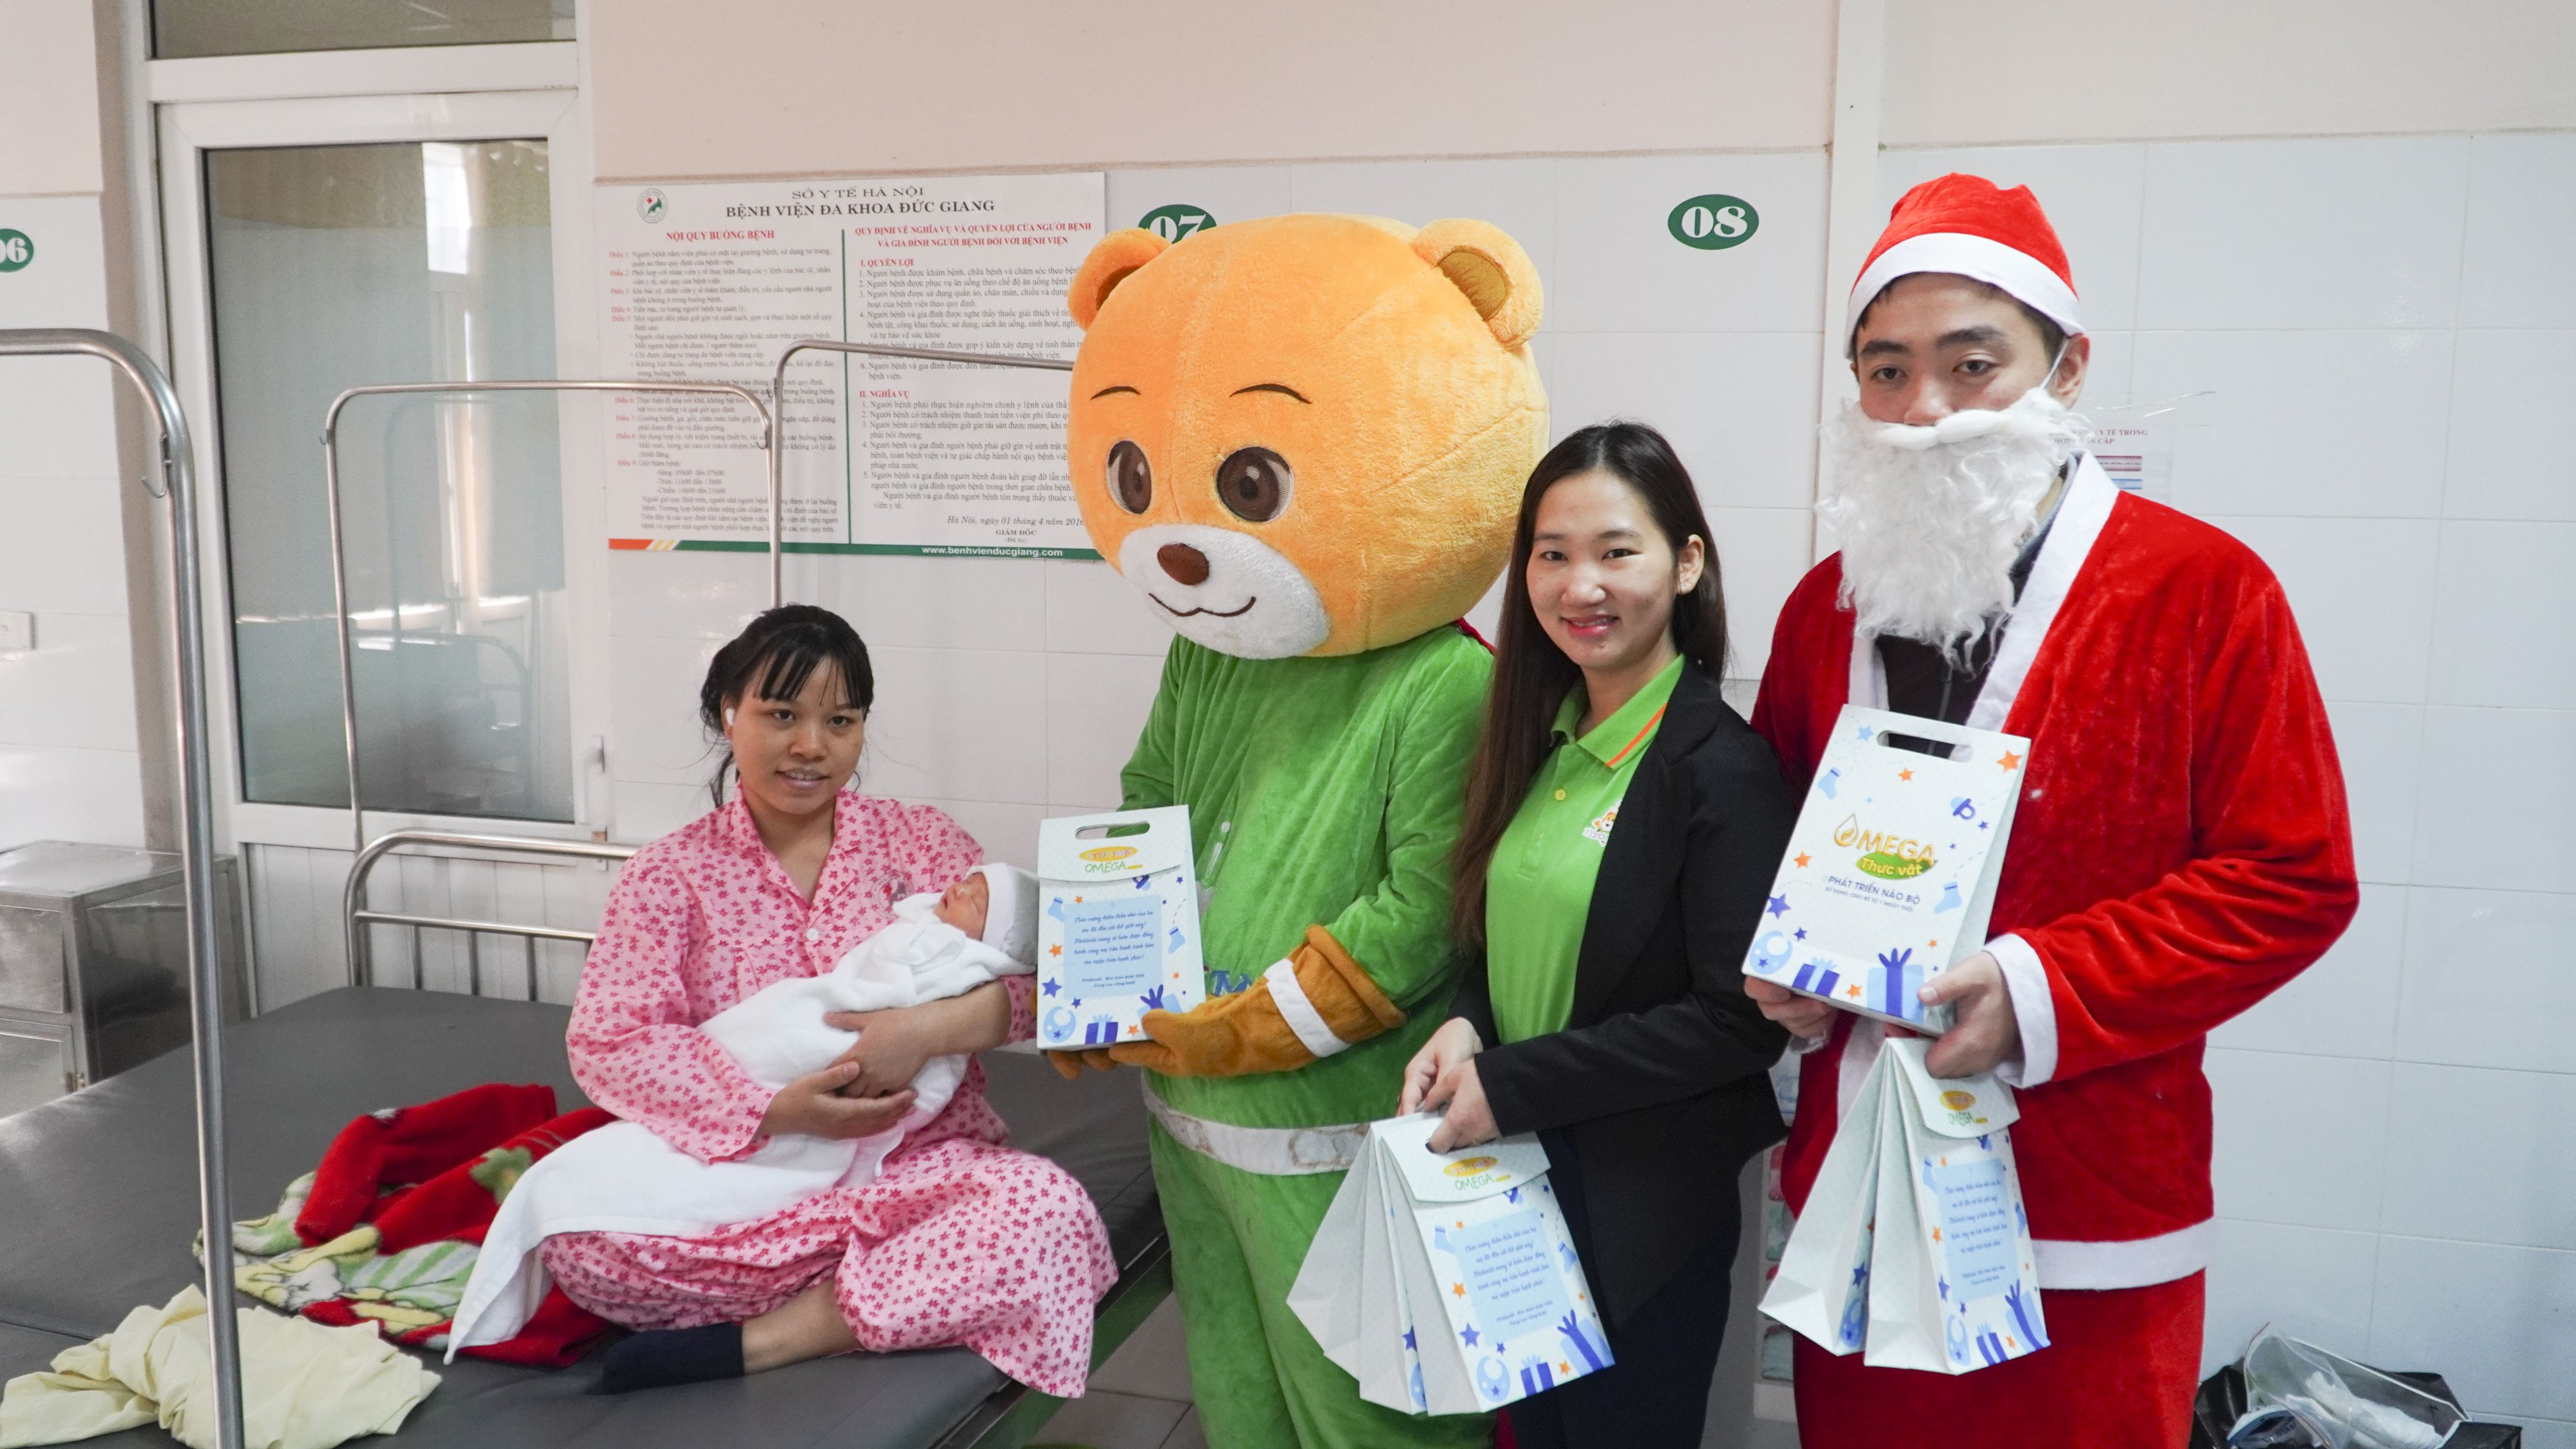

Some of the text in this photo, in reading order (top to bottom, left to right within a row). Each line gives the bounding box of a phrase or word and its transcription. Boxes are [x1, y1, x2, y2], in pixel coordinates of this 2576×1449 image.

[792, 189, 813, 199] SỞ
[835, 187, 856, 197] TẾ
[863, 187, 886, 197] HÀ
[893, 186, 923, 197] NỘI
[727, 199, 994, 219] BỆNH VIỆN ĐA KHOA ĐỨC GIANG
[855, 221, 1091, 236] QUY ĐỊNH VỀ NGHĨA VỤ VÀ QUYỀN LỢI CỦA NGƯỜI BỆNH
[1681, 206, 1748, 238] 08
[667, 228, 774, 242] NỘI QUY BUỒNG BỆNH
[1150, 214, 1206, 244] 07
[878, 238, 889, 247] VÀ
[908, 237, 928, 247] ĐÌNH
[931, 236, 959, 246] NGƯỜI
[961, 236, 984, 247] BỆNH
[986, 236, 1001, 245] ĐỐI
[1004, 236, 1019, 245] VỚI
[1022, 235, 1045, 246] BỆNH
[1047, 235, 1067, 245] VIỆN
[0, 238, 28, 263] 6
[867, 257, 896, 268] QUYỀN
[898, 259, 913, 267] LỢI
[867, 269, 888, 279] Người
[889, 269, 906, 277] bệnh
[907, 269, 924, 277] được
[947, 268, 965, 277] bệnh,
[986, 267, 1002, 276] bệnh
[1066, 266, 1079, 275] bện
[867, 279, 887, 289] Người
[889, 279, 905, 288] bệnh
[906, 279, 923, 288] được
[925, 279, 941, 289] phục
[998, 276, 1010, 286] chế
[1012, 278, 1020, 287] độ
[1051, 277, 1068, 286] bệnh
[867, 289, 888, 299] Người
[889, 289, 905, 298] bệnh
[907, 289, 923, 298] được
[935, 289, 952, 298] dụng
[1051, 287, 1068, 297] dụng
[869, 388, 896, 397] NGHĨA
[898, 390, 908, 399] VỤ
[871, 401, 892, 410] Người
[894, 401, 911, 409] bệnh
[913, 401, 928, 410] phải
[930, 401, 946, 409] thực
[949, 401, 964, 409] hiện
[1023, 401, 1039, 409] lệnh
[961, 516, 976, 525] Nội,
[980, 516, 998, 526] ngày
[1013, 517, 1035, 527] tháng
[922, 547, 1062, 557] www.benhvienducgiang.com
[1084, 861, 1126, 873] OMEGA
[1861, 857, 1923, 879] Thực vật
[1828, 876, 1921, 906] PHÁT TRIỂN NÃO BỘ
[1454, 1173, 1495, 1191] OMEGA
